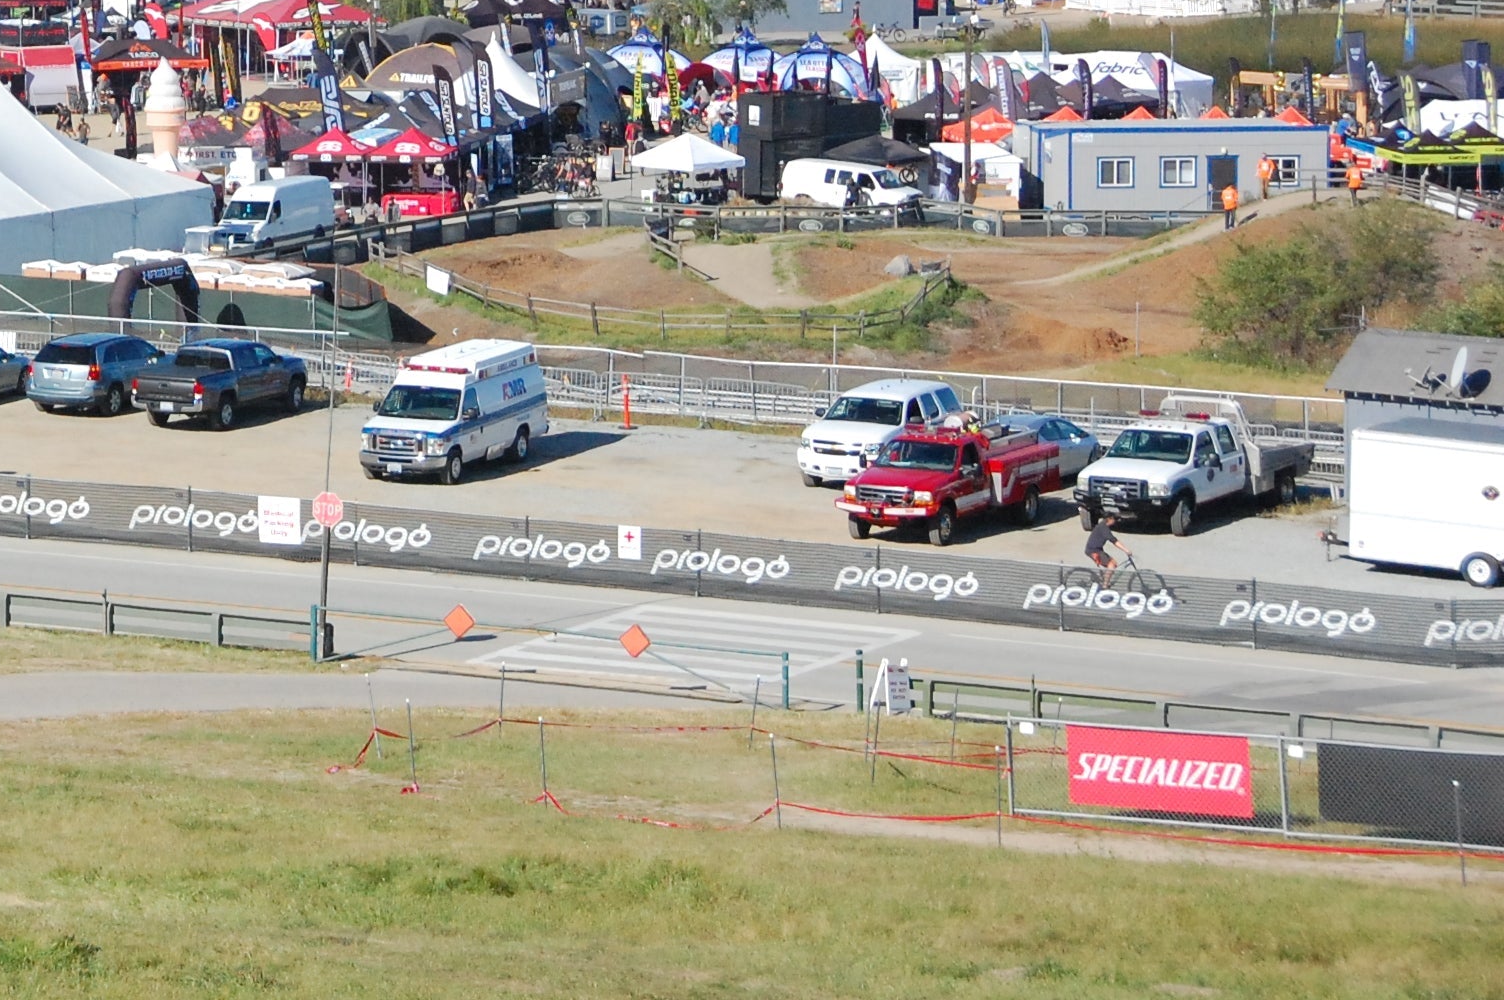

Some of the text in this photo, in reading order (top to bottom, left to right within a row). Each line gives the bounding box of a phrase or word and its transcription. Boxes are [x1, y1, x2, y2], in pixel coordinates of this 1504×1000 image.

[1093, 61, 1145, 76] fabric
[996, 64, 1009, 119] manitou
[128, 503, 259, 537] prologo
[314, 502, 342, 517] STOP
[473, 533, 611, 568] prologo
[651, 548, 790, 584] prologo
[834, 565, 979, 600] prologo
[1022, 582, 1173, 618] prologo
[1220, 599, 1376, 637] prologo
[1073, 752, 1244, 792] SPECIALIZED
